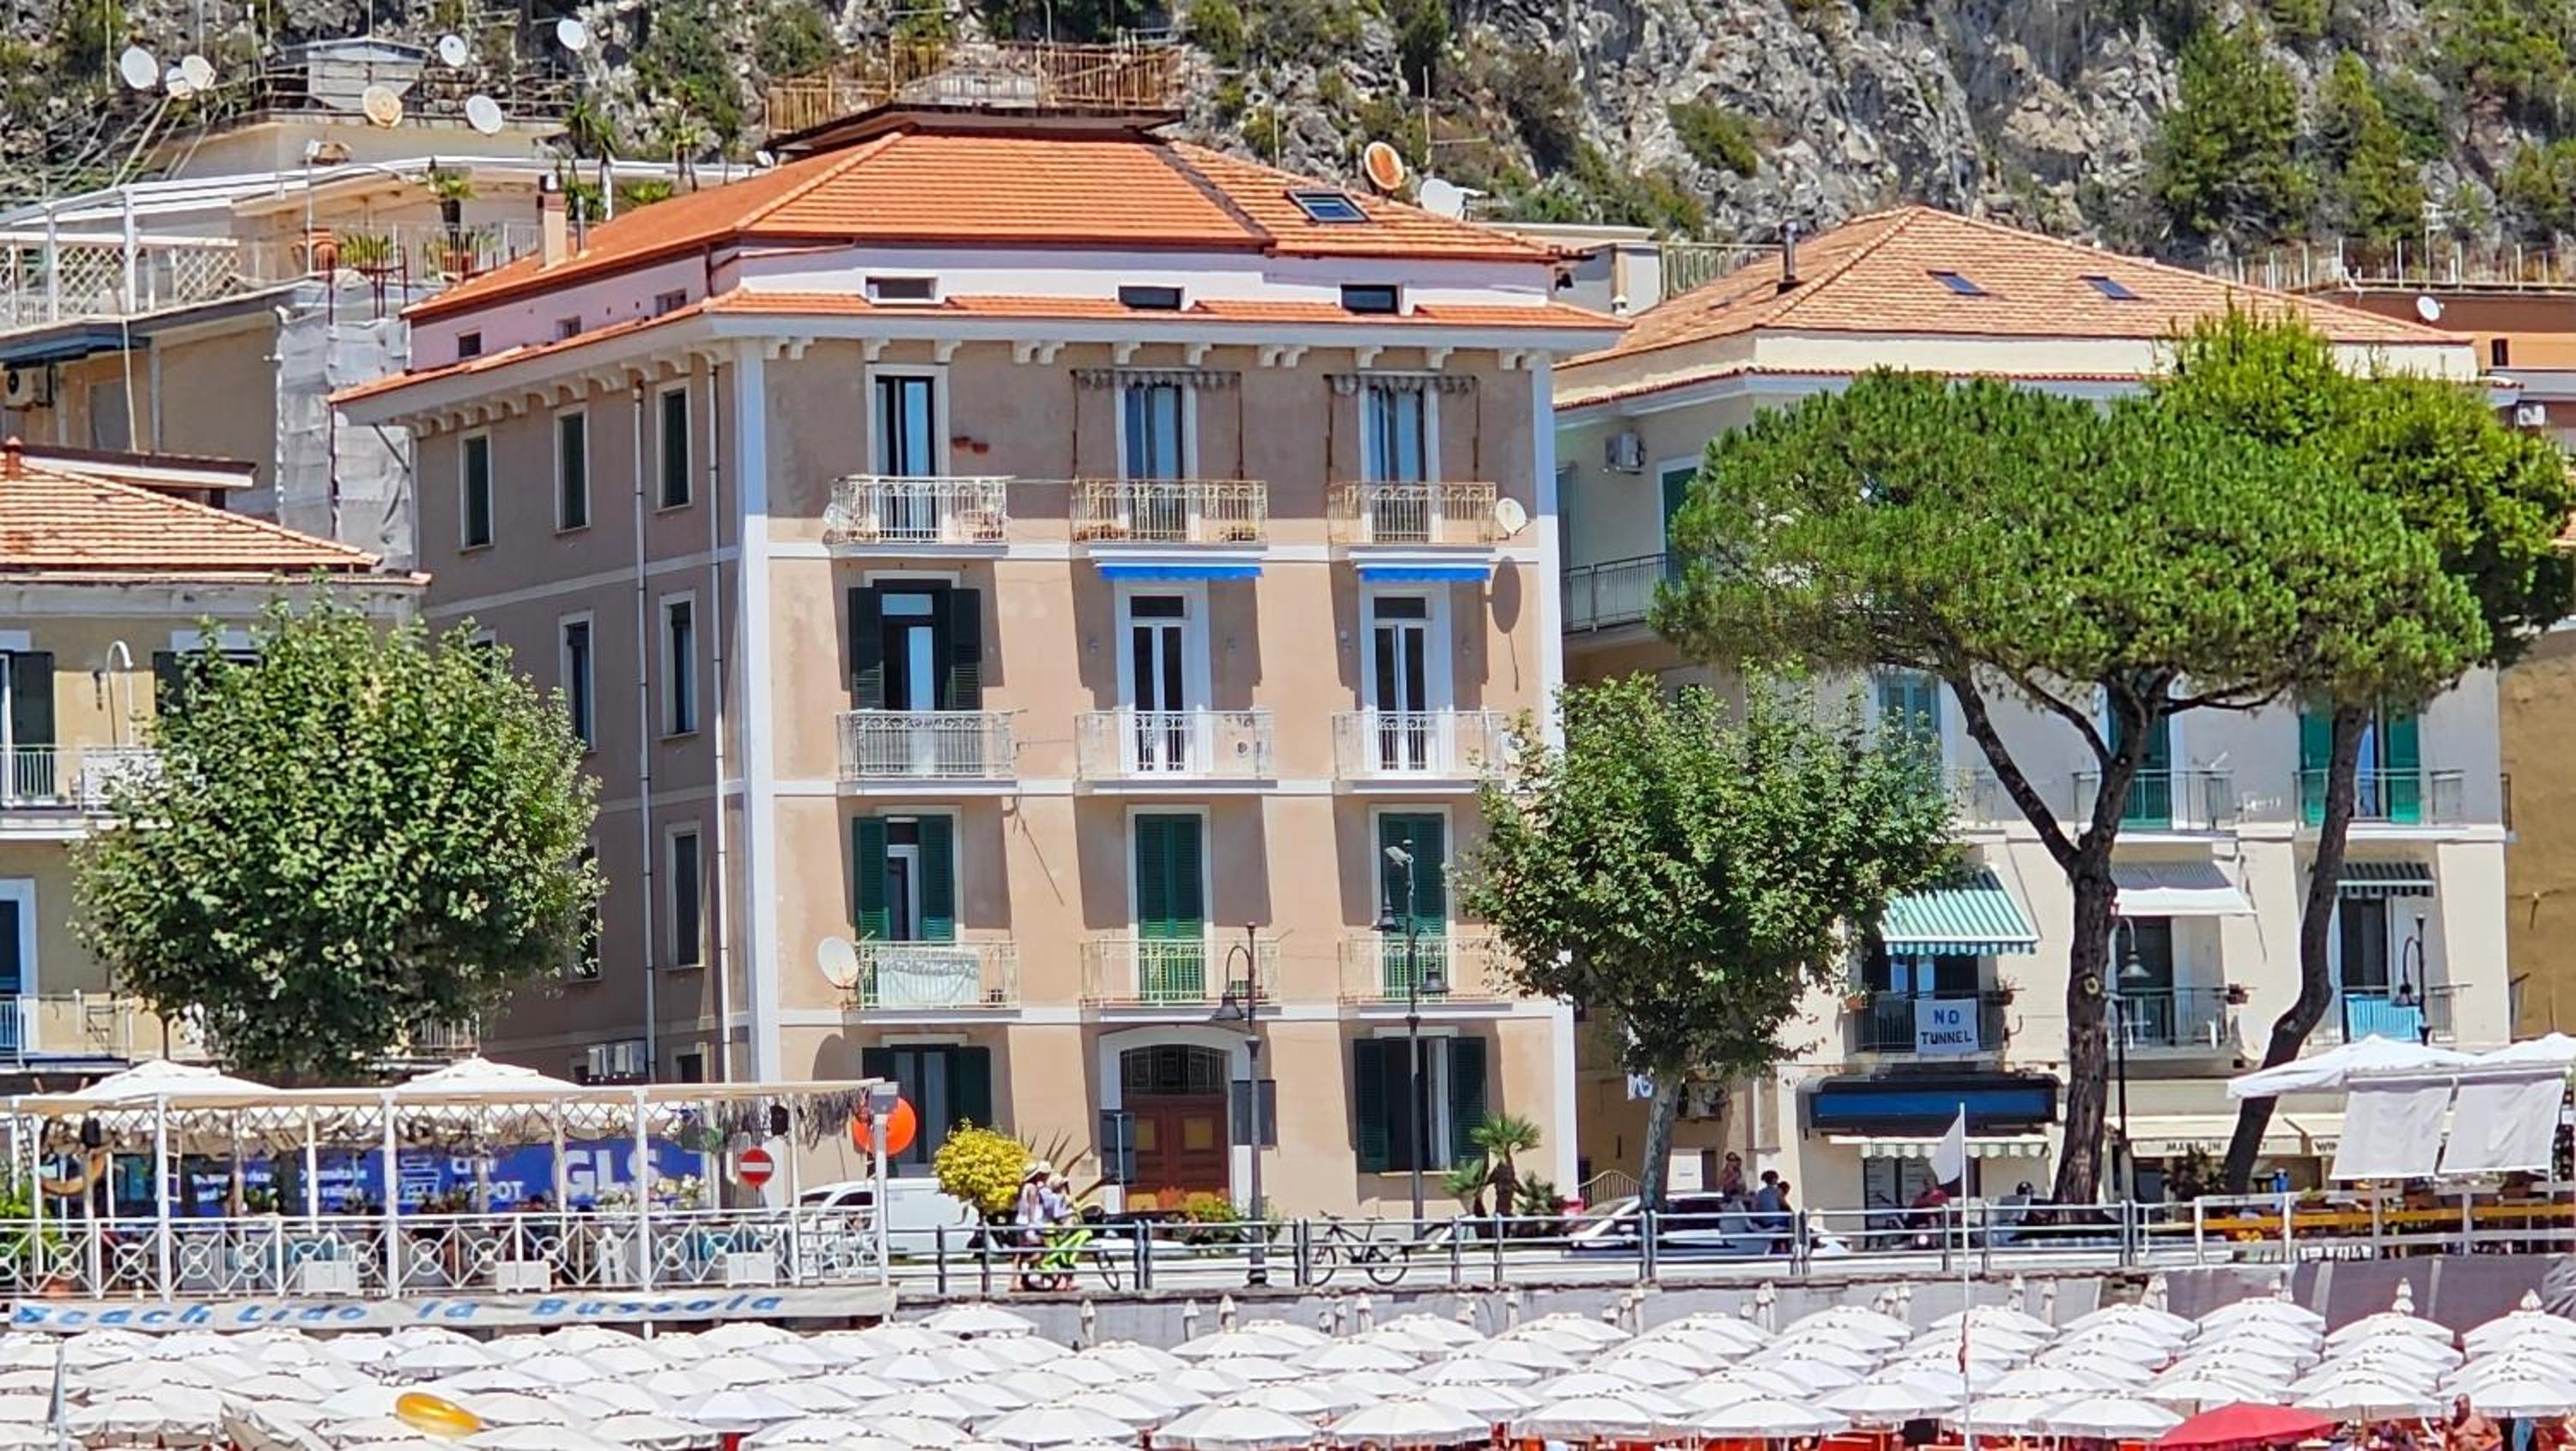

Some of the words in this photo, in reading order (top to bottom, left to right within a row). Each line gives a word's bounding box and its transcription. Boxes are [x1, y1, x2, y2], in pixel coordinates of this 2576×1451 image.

[1933, 1009, 1960, 1025] NO
[1920, 1029, 1973, 1045] TUNNEL
[551, 1149, 660, 1197] GLS
[12, 1304, 211, 1324] Beach
[236, 1303, 368, 1321] Lido
[416, 1300, 481, 1319] la
[531, 1294, 782, 1315] Bussola
